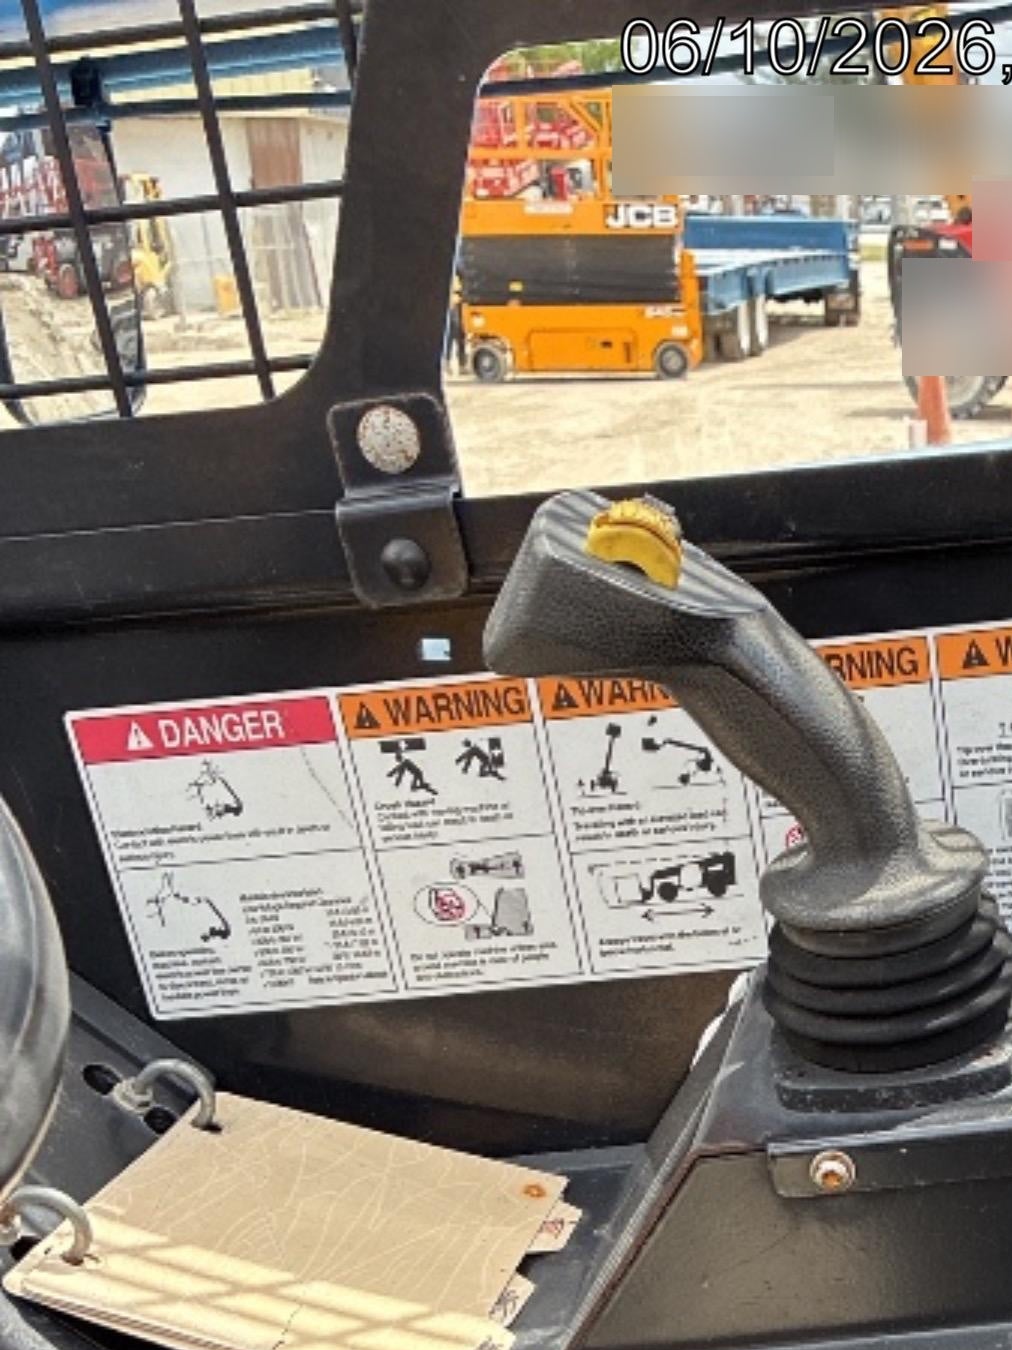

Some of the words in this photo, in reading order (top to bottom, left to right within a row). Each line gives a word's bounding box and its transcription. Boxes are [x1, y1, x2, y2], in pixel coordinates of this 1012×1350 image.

[605, 204, 679, 229] JCB
[824, 646, 919, 681] RNING
[384, 686, 526, 727] WARNING
[158, 709, 286, 749] DANGER
